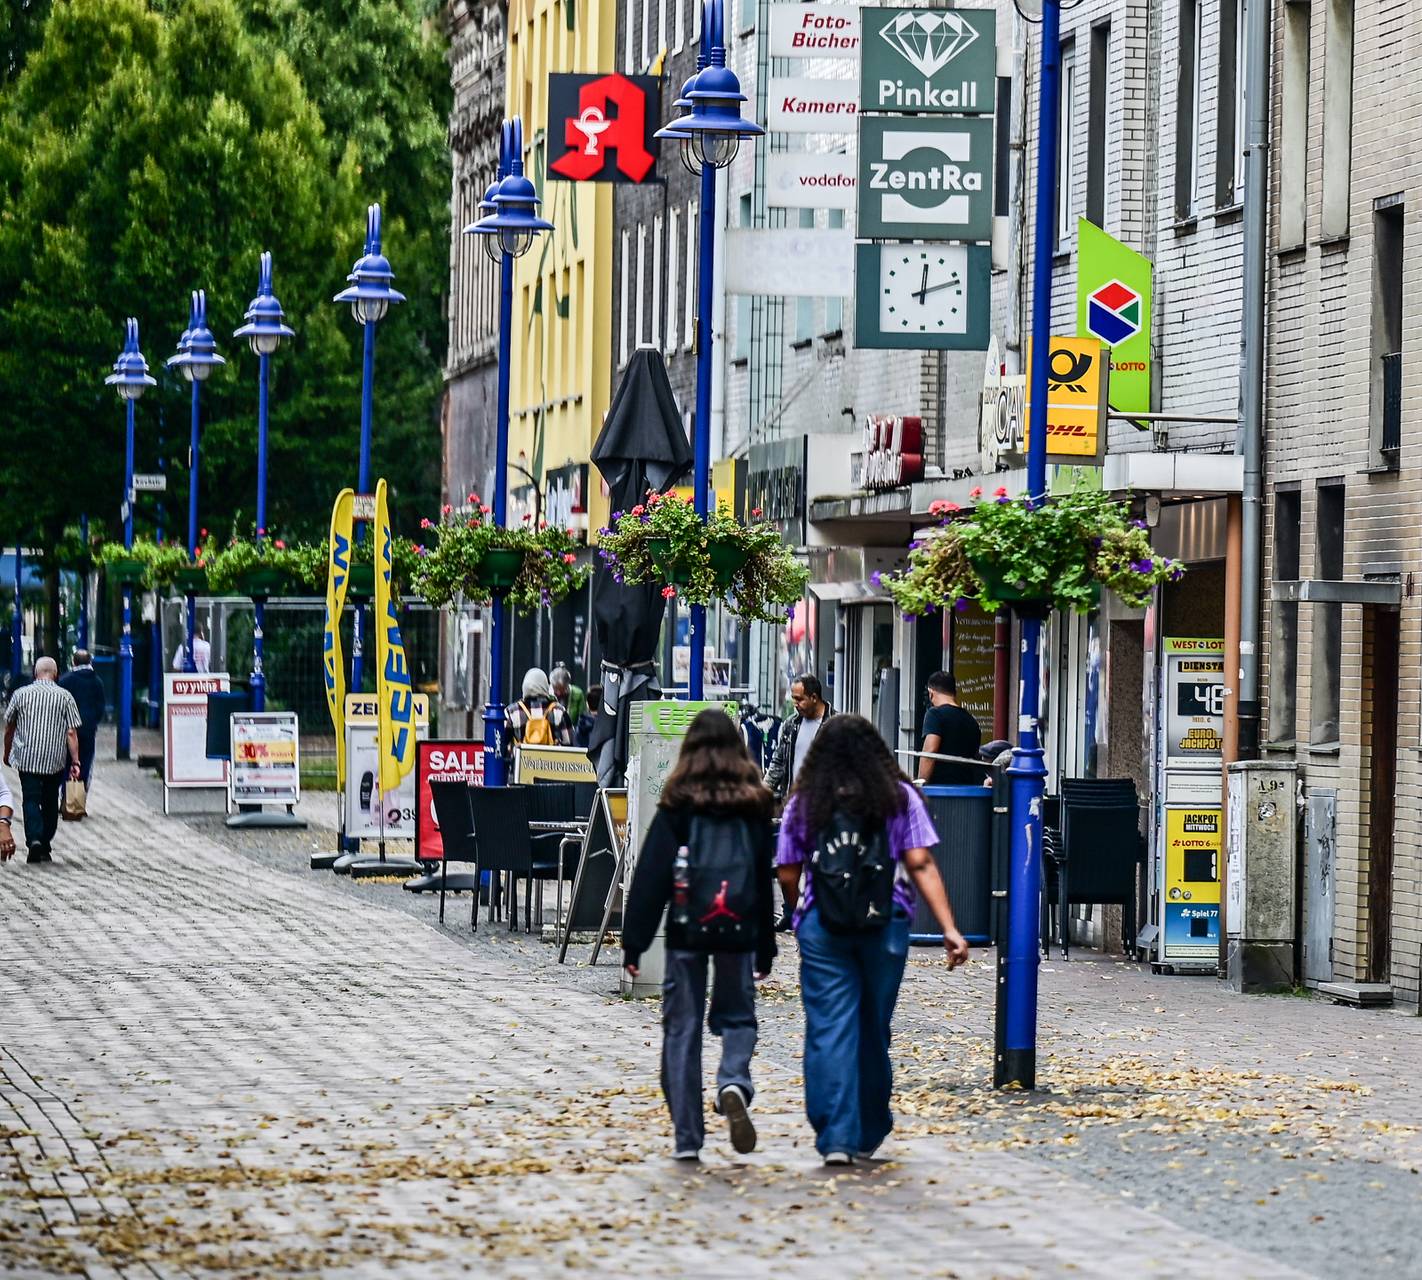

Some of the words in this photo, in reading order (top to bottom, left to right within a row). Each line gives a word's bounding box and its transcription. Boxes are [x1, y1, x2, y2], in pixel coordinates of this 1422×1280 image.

[802, 13, 851, 29] Foto-
[792, 31, 859, 48] Bücher
[879, 79, 977, 107] Pinkall
[782, 97, 856, 113] Kamera
[870, 162, 982, 191] ZentRa
[1116, 362, 1146, 371] LOTTO
[1172, 640, 1198, 649] WEST
[962, 701, 989, 711] Pinkall
[1180, 739, 1222, 749] JACKPOT
[429, 751, 484, 770] SALE
[1184, 815, 1218, 824] JACKPOT
[1192, 910, 1209, 918] Spiel
